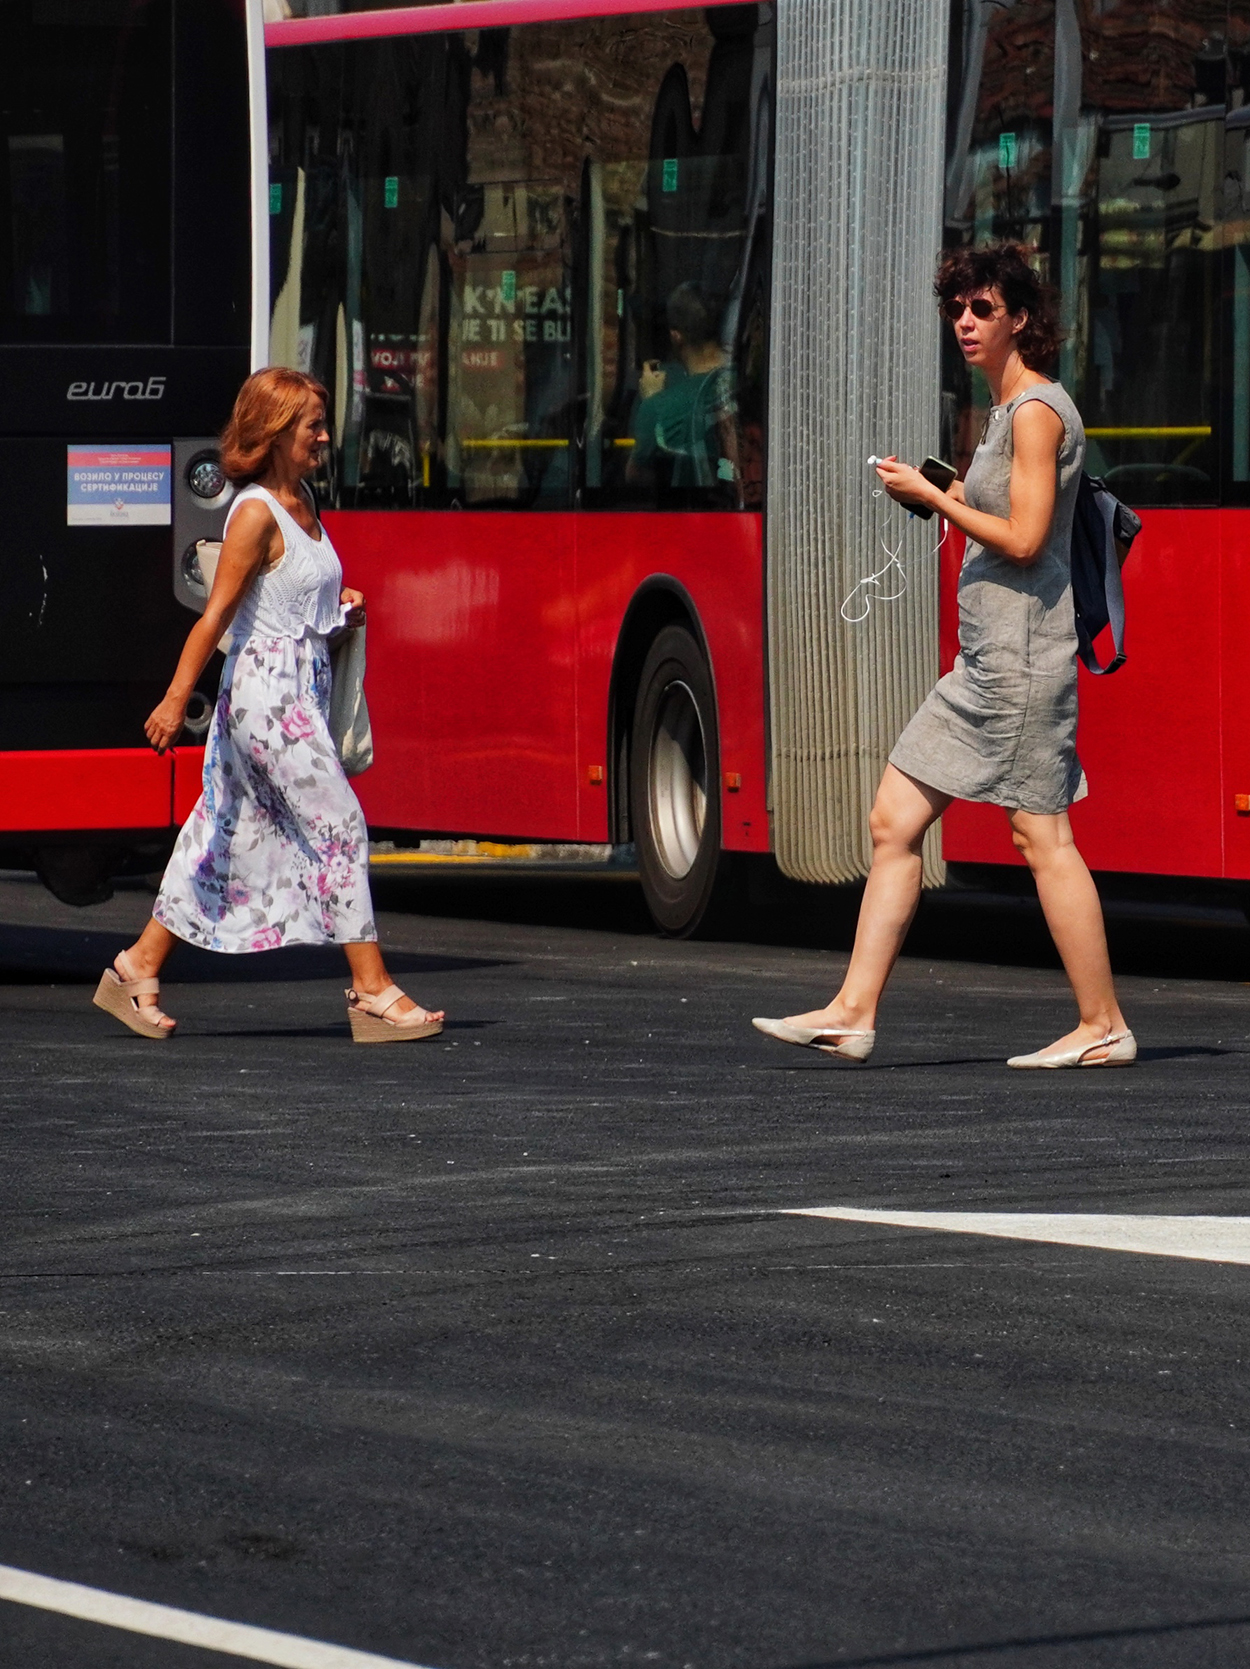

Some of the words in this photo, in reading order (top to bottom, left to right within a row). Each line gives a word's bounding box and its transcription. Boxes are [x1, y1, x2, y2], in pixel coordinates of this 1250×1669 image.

[66, 376, 167, 400] euro6
[74, 472, 112, 481] ВОЗИЛО
[114, 472, 121, 481] У
[122, 472, 165, 482] ПРОЦЕСУ
[80, 483, 159, 492] СЕРТИФИКАЦИЈЕ
